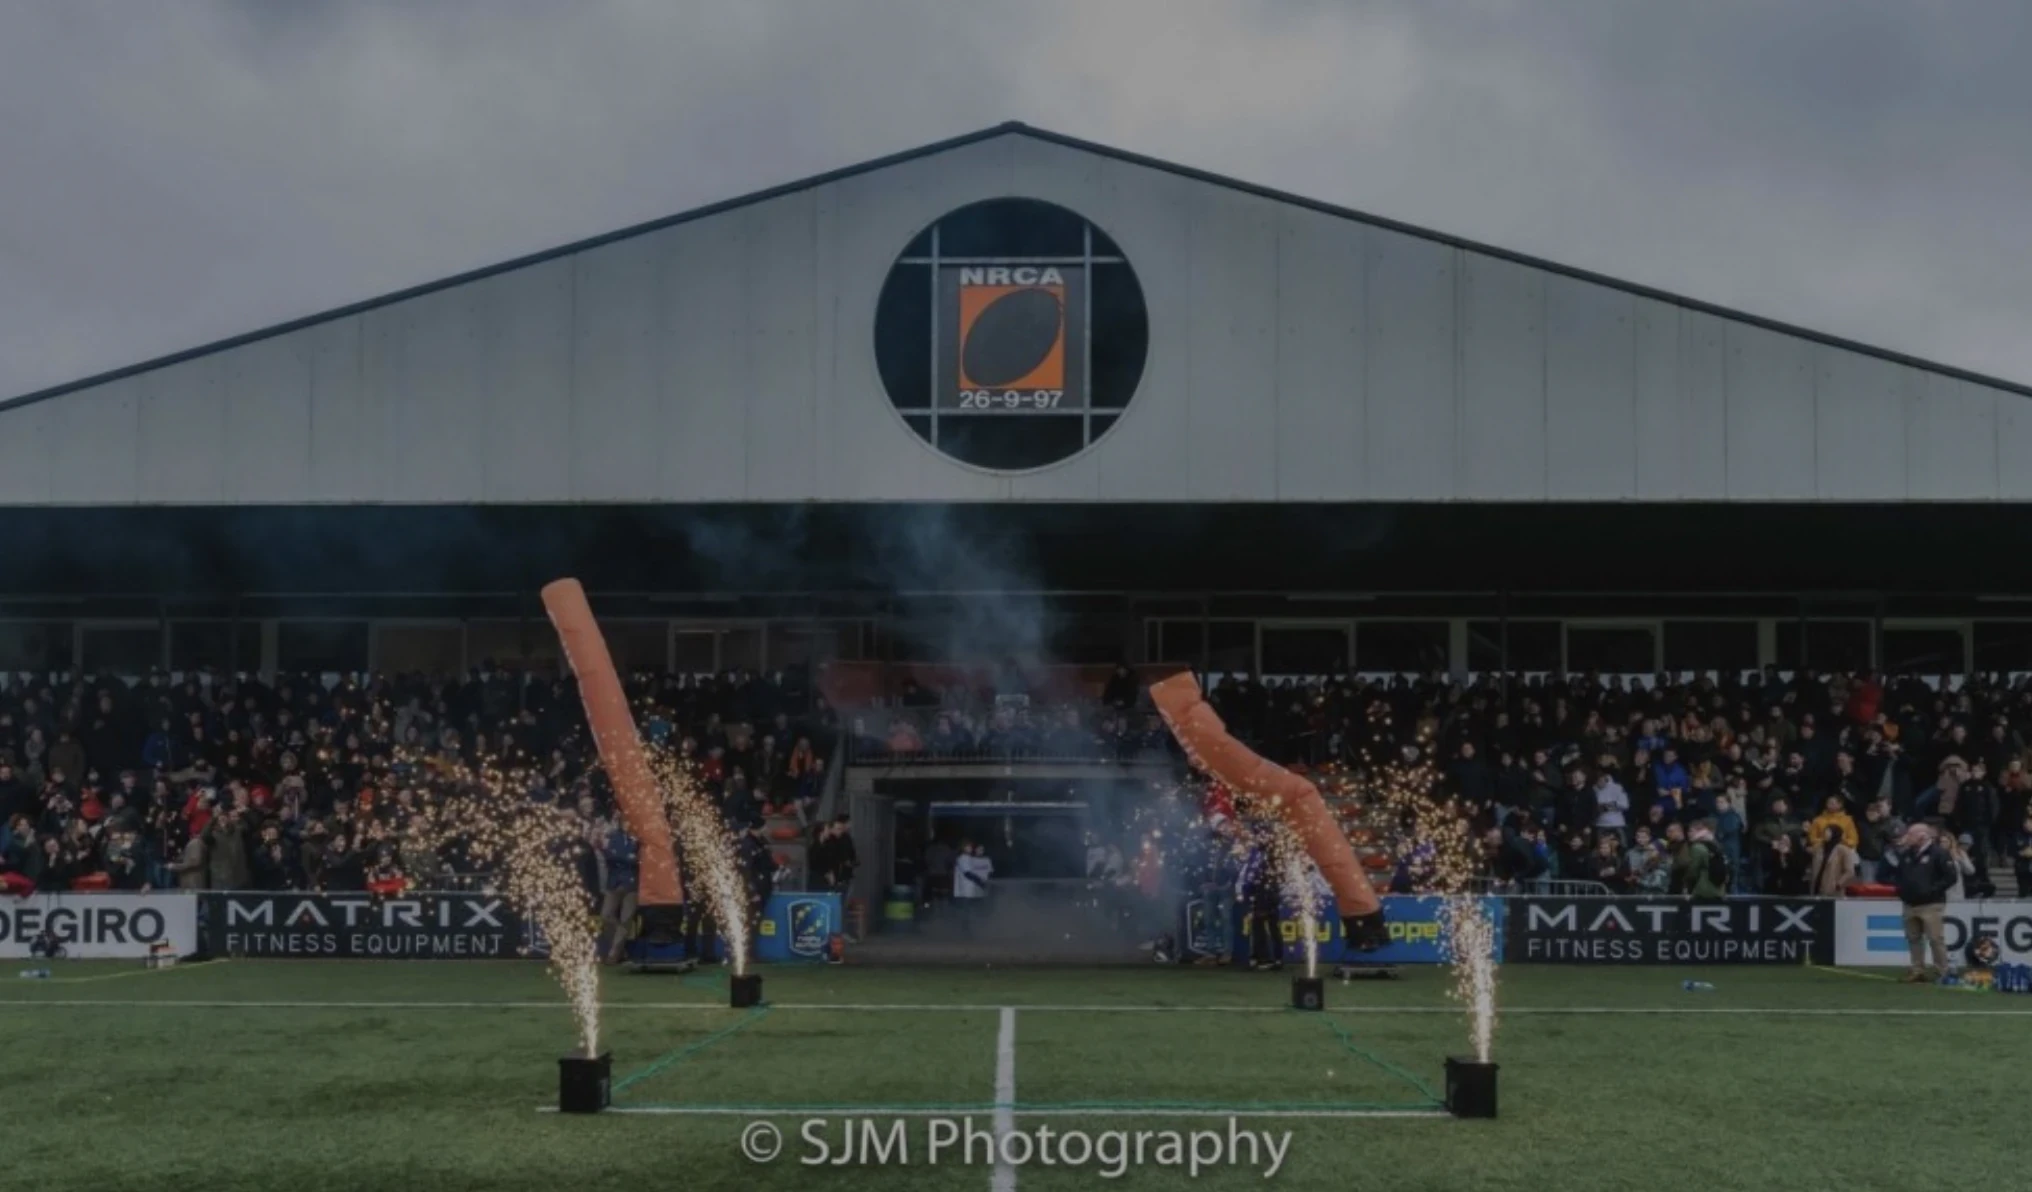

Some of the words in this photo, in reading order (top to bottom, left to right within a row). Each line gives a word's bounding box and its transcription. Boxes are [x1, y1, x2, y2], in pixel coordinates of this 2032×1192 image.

[960, 267, 1064, 286] NRCA
[959, 390, 1064, 409] 26-9-97
[226, 899, 504, 927] MATRIX
[1528, 905, 1815, 932] MATRIX
[226, 933, 337, 954] FITNESS
[351, 934, 503, 955] EQUIPMENT
[1528, 939, 1643, 959] FITNESS
[1658, 940, 1815, 960] EQUIPMENT
